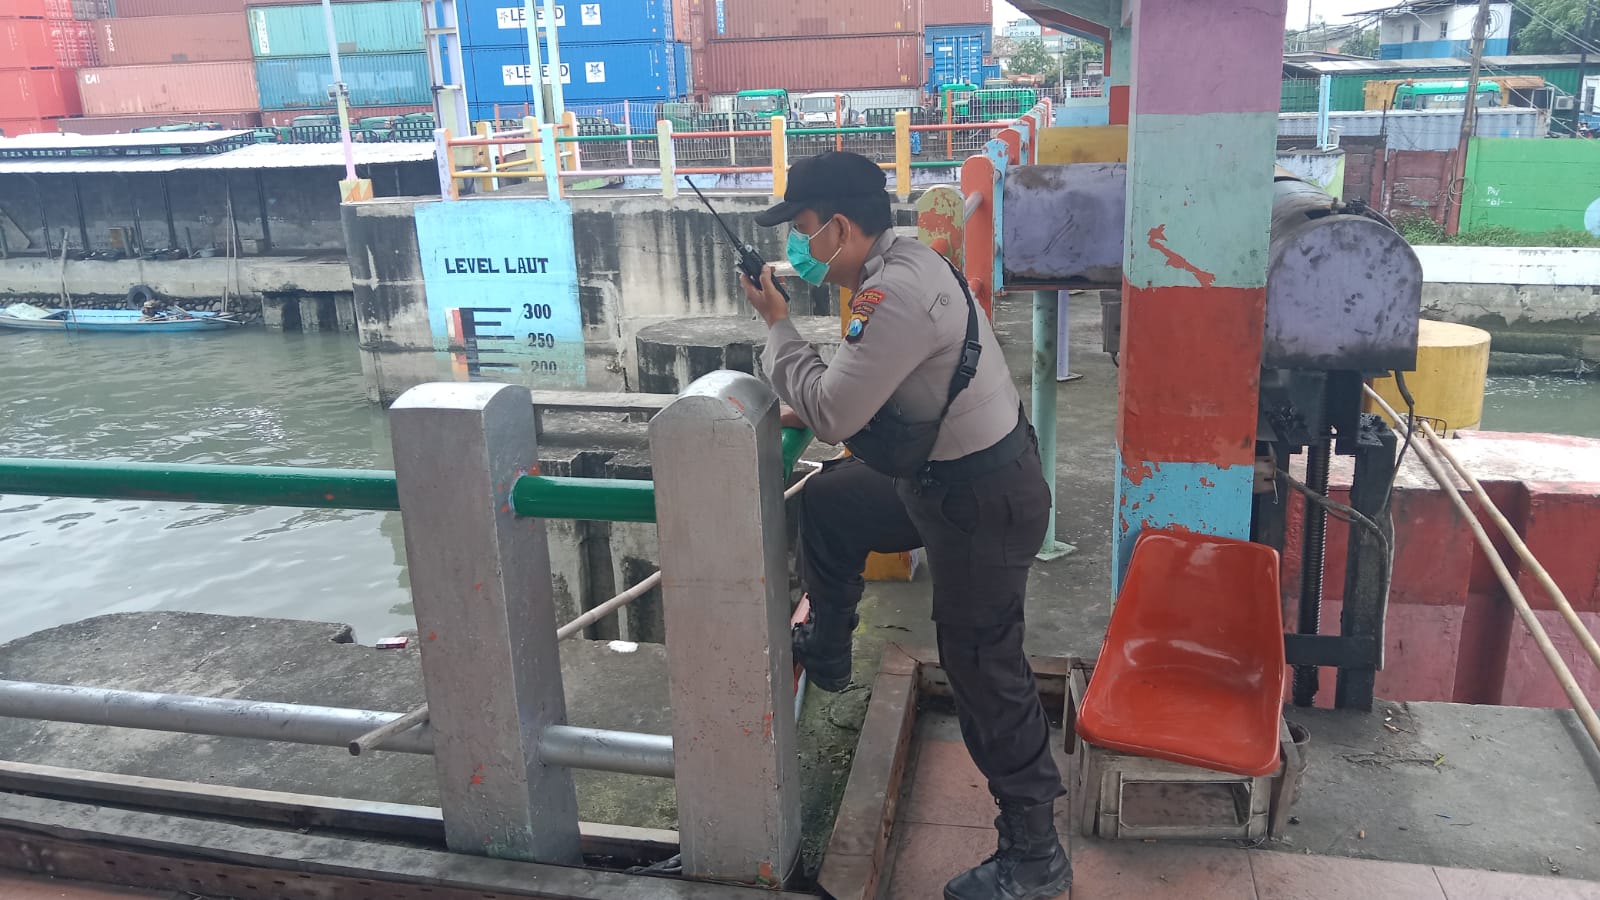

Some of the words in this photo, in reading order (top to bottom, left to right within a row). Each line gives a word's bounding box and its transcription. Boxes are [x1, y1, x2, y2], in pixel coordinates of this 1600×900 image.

[511, 7, 563, 21] LEED
[85, 74, 100, 84] CAI
[516, 65, 568, 78] LEED
[445, 258, 500, 274] LEVEL
[504, 257, 549, 274] LAUT
[523, 303, 552, 320] 300
[528, 333, 555, 349] 250
[531, 360, 557, 376] 200
